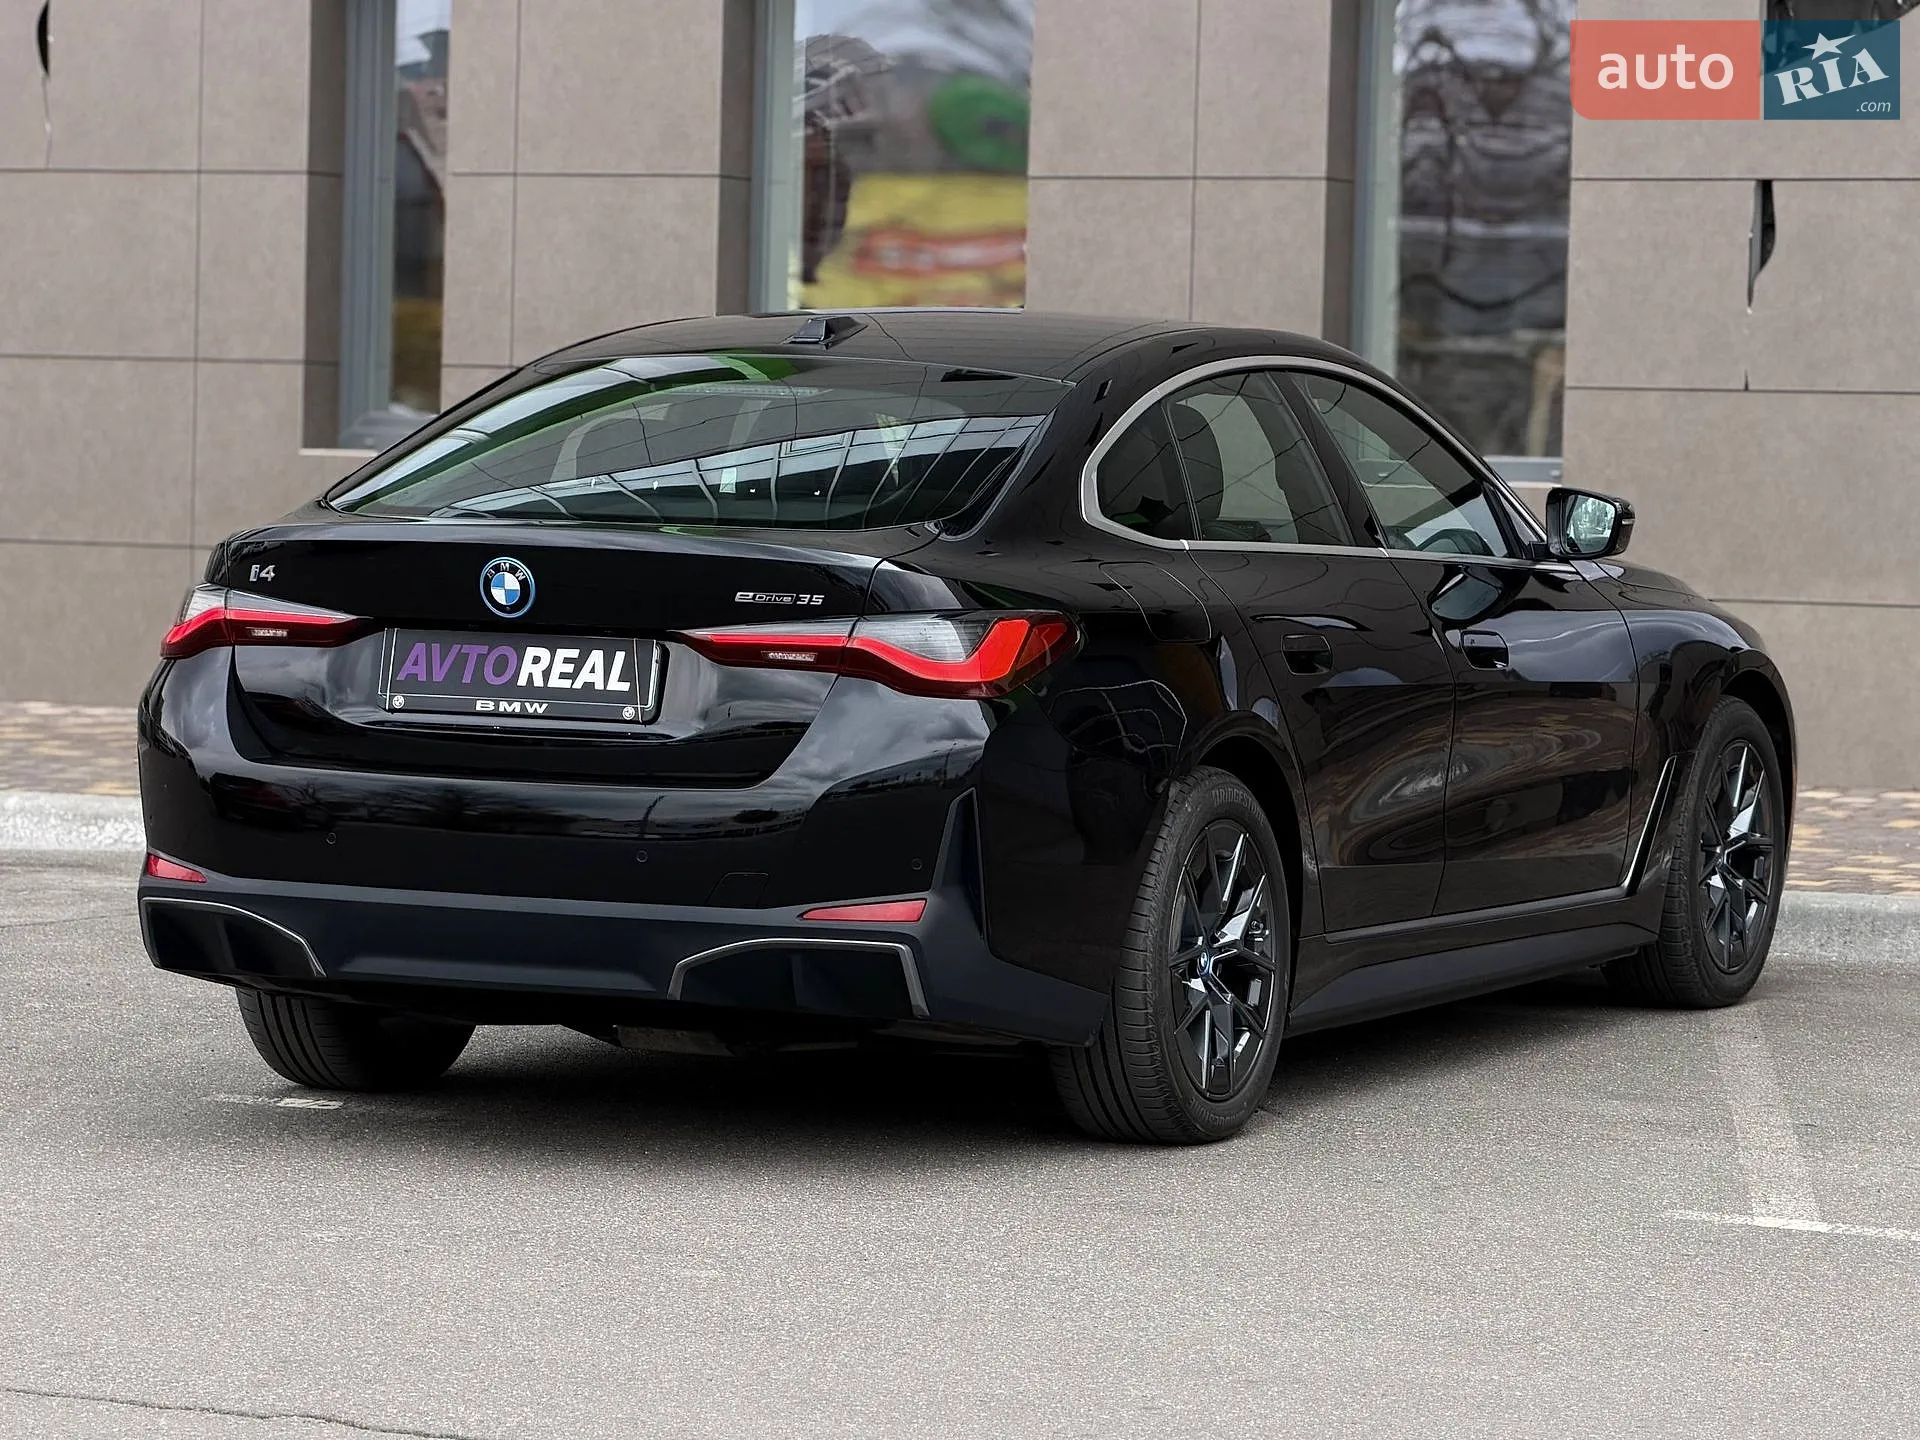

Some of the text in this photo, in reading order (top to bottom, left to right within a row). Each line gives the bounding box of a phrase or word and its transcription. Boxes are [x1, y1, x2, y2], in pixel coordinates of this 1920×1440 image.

[249, 564, 276, 582] i4
[796, 594, 825, 605] 35
[397, 642, 631, 692] AVTOREAL
[475, 699, 549, 714] BMW
